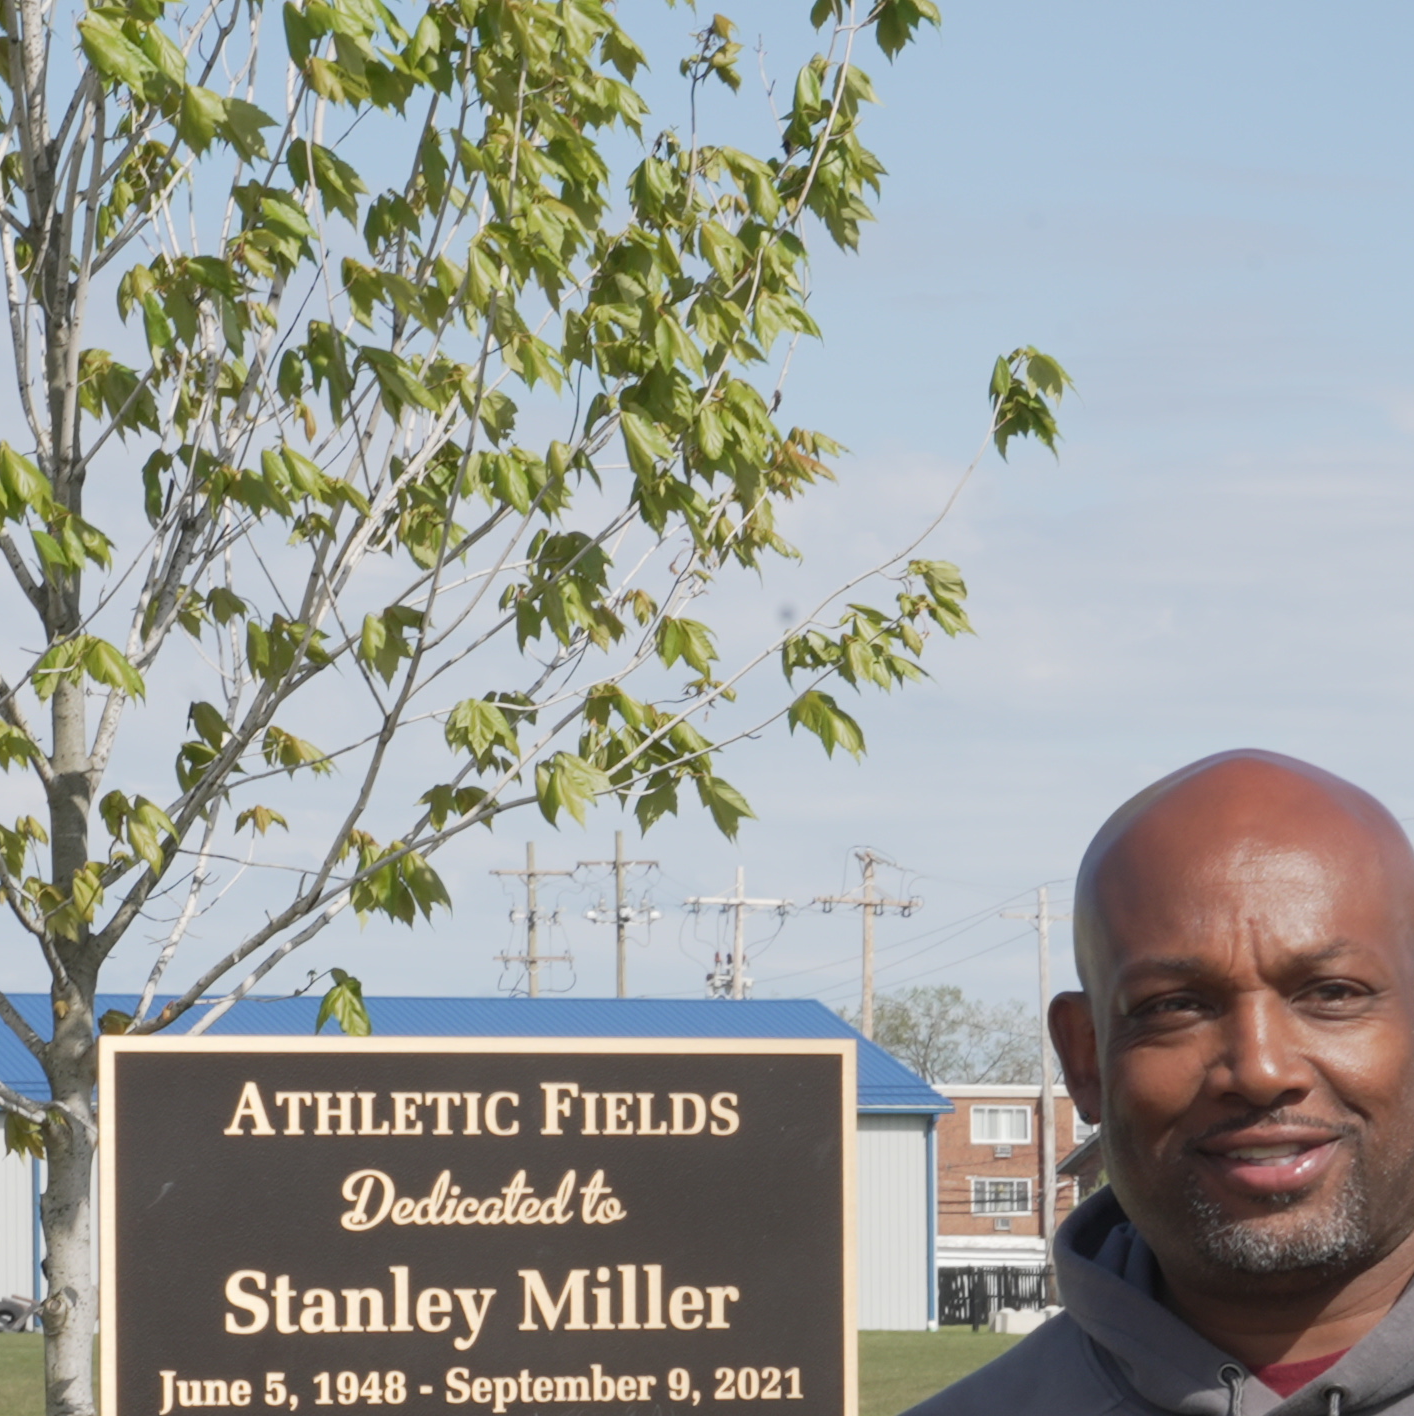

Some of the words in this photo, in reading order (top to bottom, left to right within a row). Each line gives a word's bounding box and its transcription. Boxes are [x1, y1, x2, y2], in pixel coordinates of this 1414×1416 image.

[223, 1081, 520, 1136] ATHLETIC
[540, 1082, 740, 1136] FIELDS
[340, 1168, 577, 1232] Dedicated
[579, 1169, 627, 1226] to
[225, 1265, 497, 1351] Stanley
[518, 1264, 740, 1332] Miller
[159, 1370, 252, 1416] June
[264, 1371, 299, 1411] 5,
[313, 1370, 407, 1405] 1948
[419, 1385, 433, 1395] -
[445, 1363, 657, 1414] September
[667, 1367, 701, 1406] 9,
[714, 1366, 804, 1400] 2021
